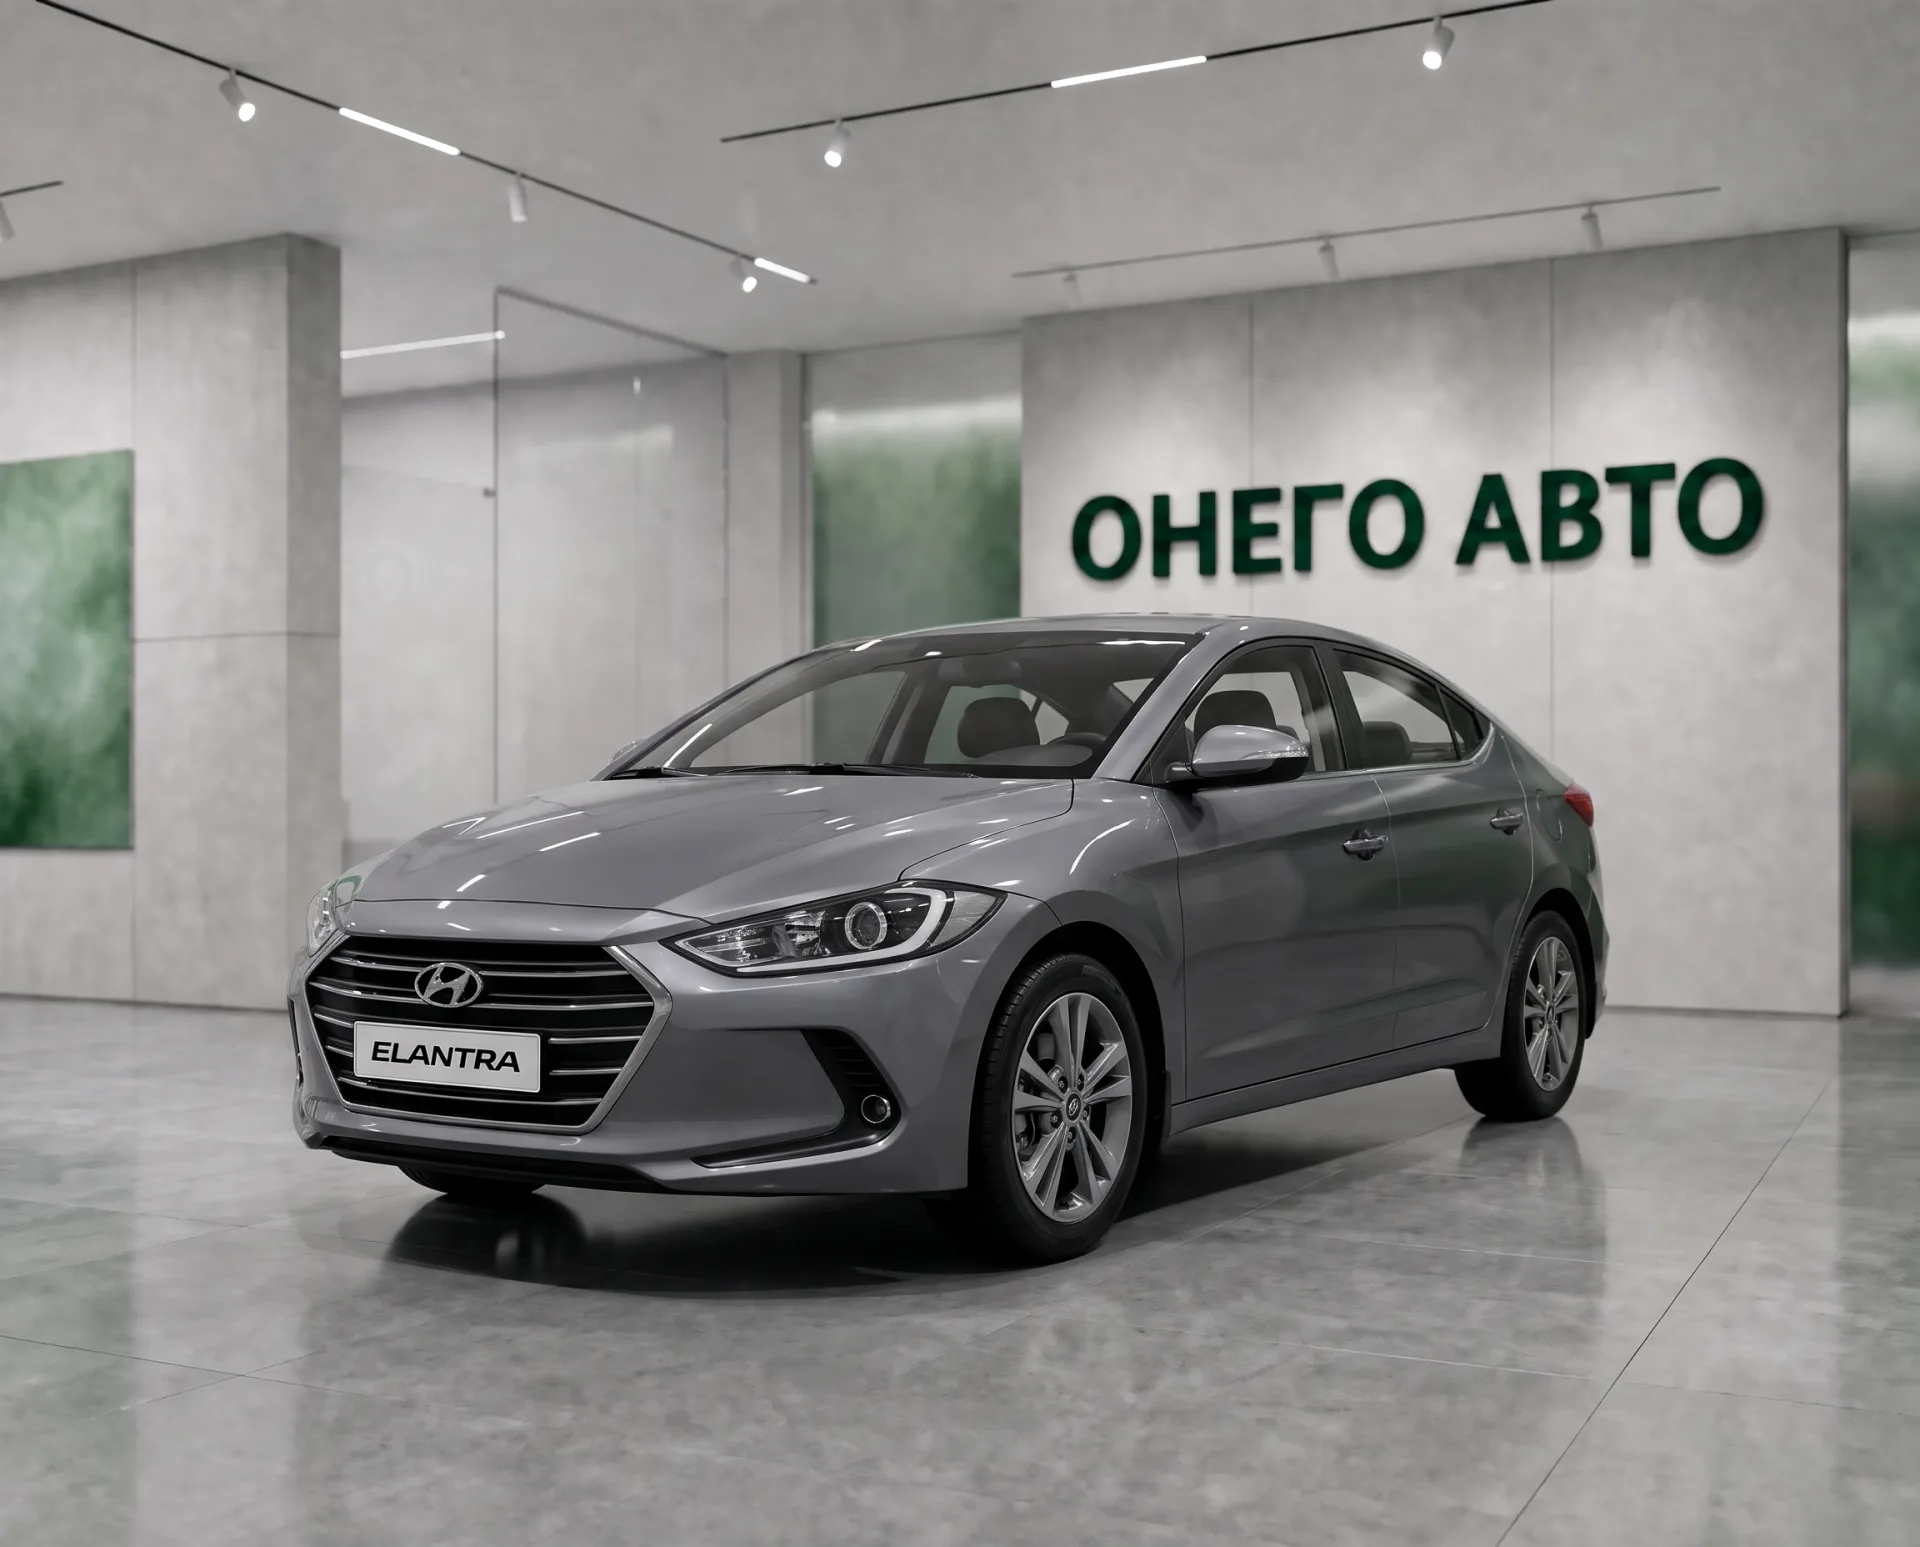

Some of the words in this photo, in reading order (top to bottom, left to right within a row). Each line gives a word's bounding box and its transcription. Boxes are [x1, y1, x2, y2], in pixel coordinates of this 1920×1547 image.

[1072, 479, 1425, 581] ОНЕГО
[1456, 457, 1764, 565] АВТО
[371, 1040, 521, 1073] ELANTRA
